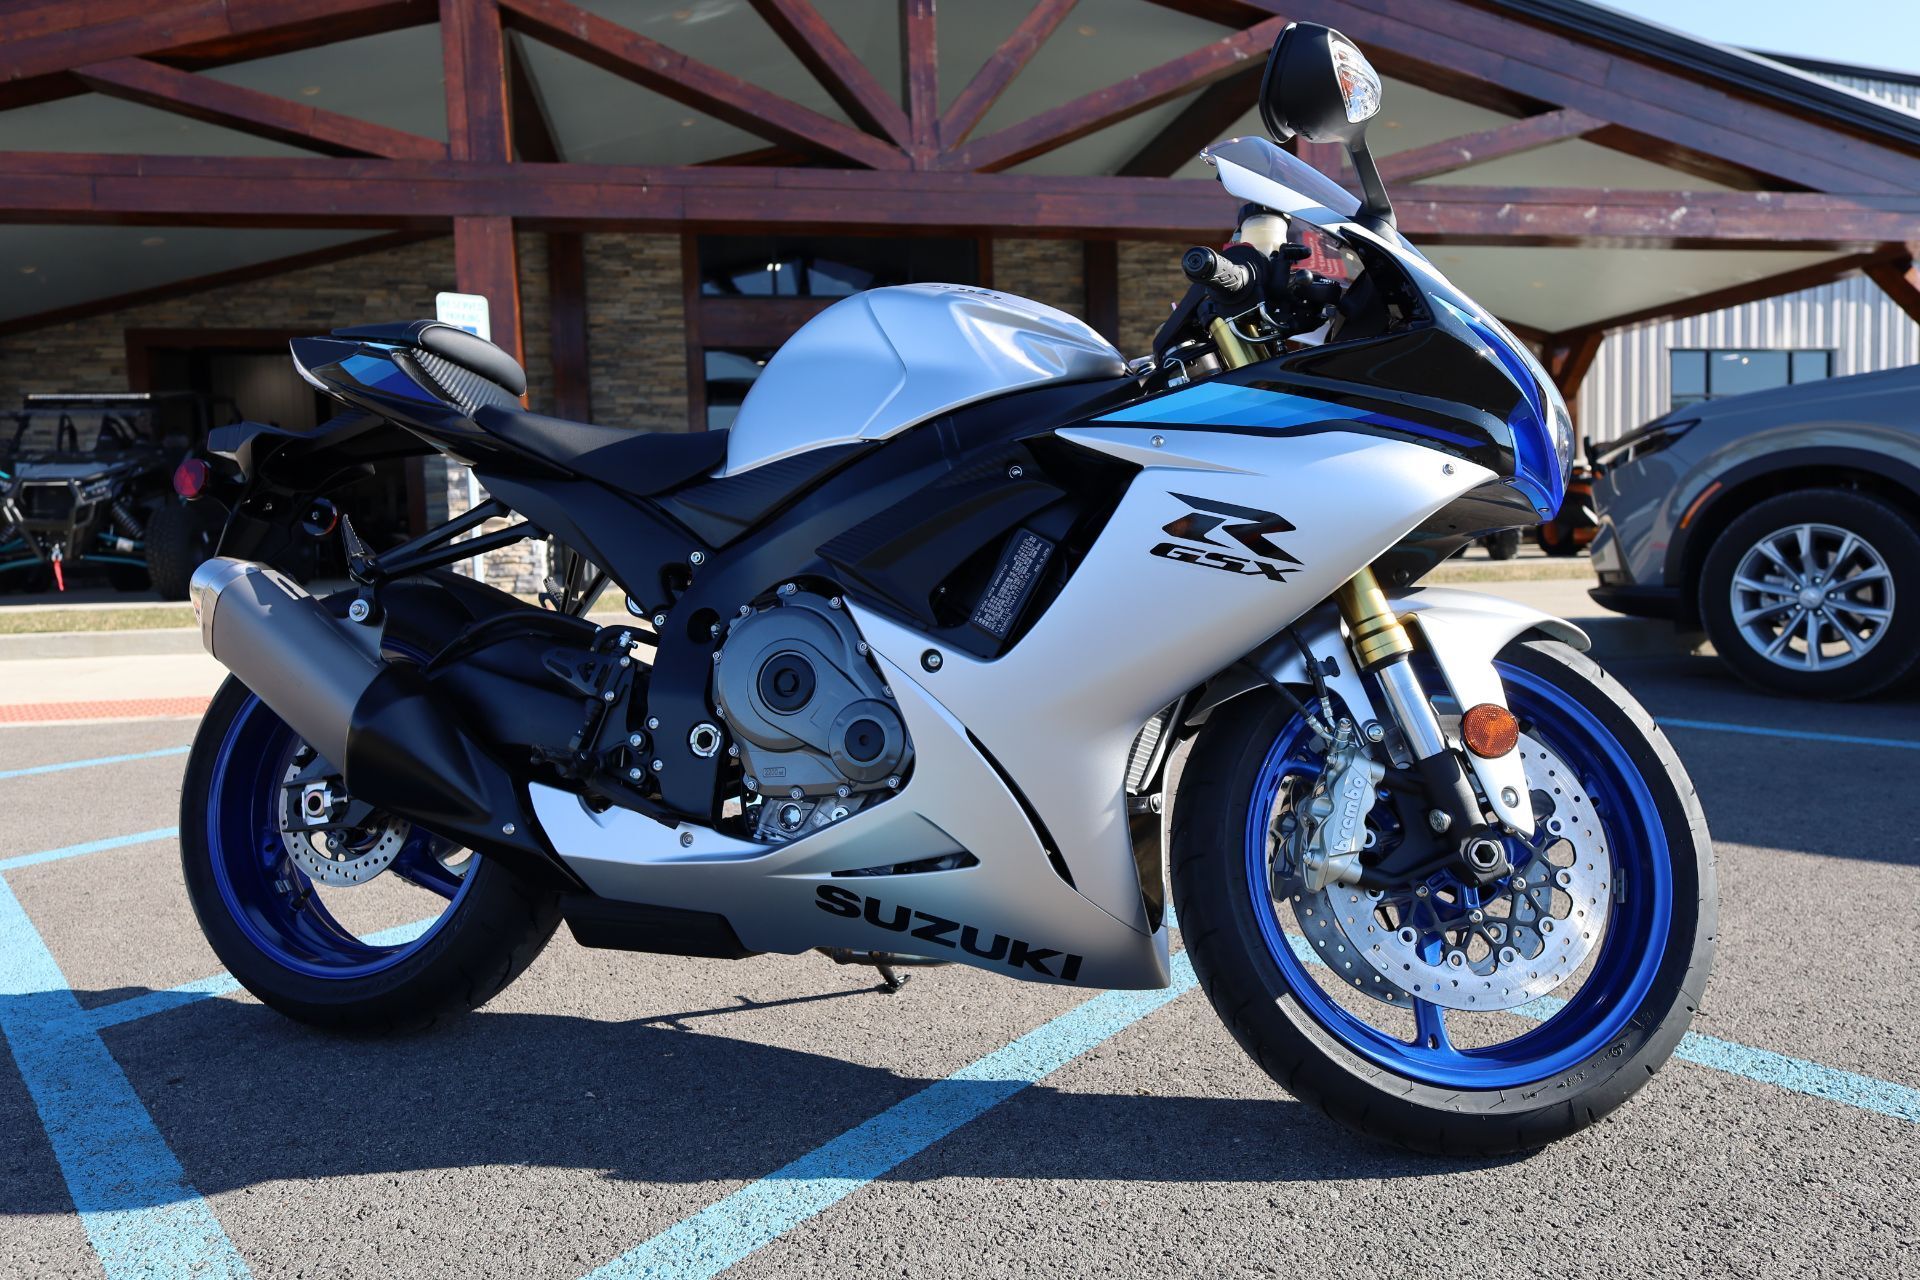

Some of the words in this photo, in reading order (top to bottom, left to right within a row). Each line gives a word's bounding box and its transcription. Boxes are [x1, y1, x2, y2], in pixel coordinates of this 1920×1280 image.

[1149, 541, 1305, 583] GSX
[1332, 776, 1367, 852] brembo
[814, 883, 1084, 983] SUZUKI
